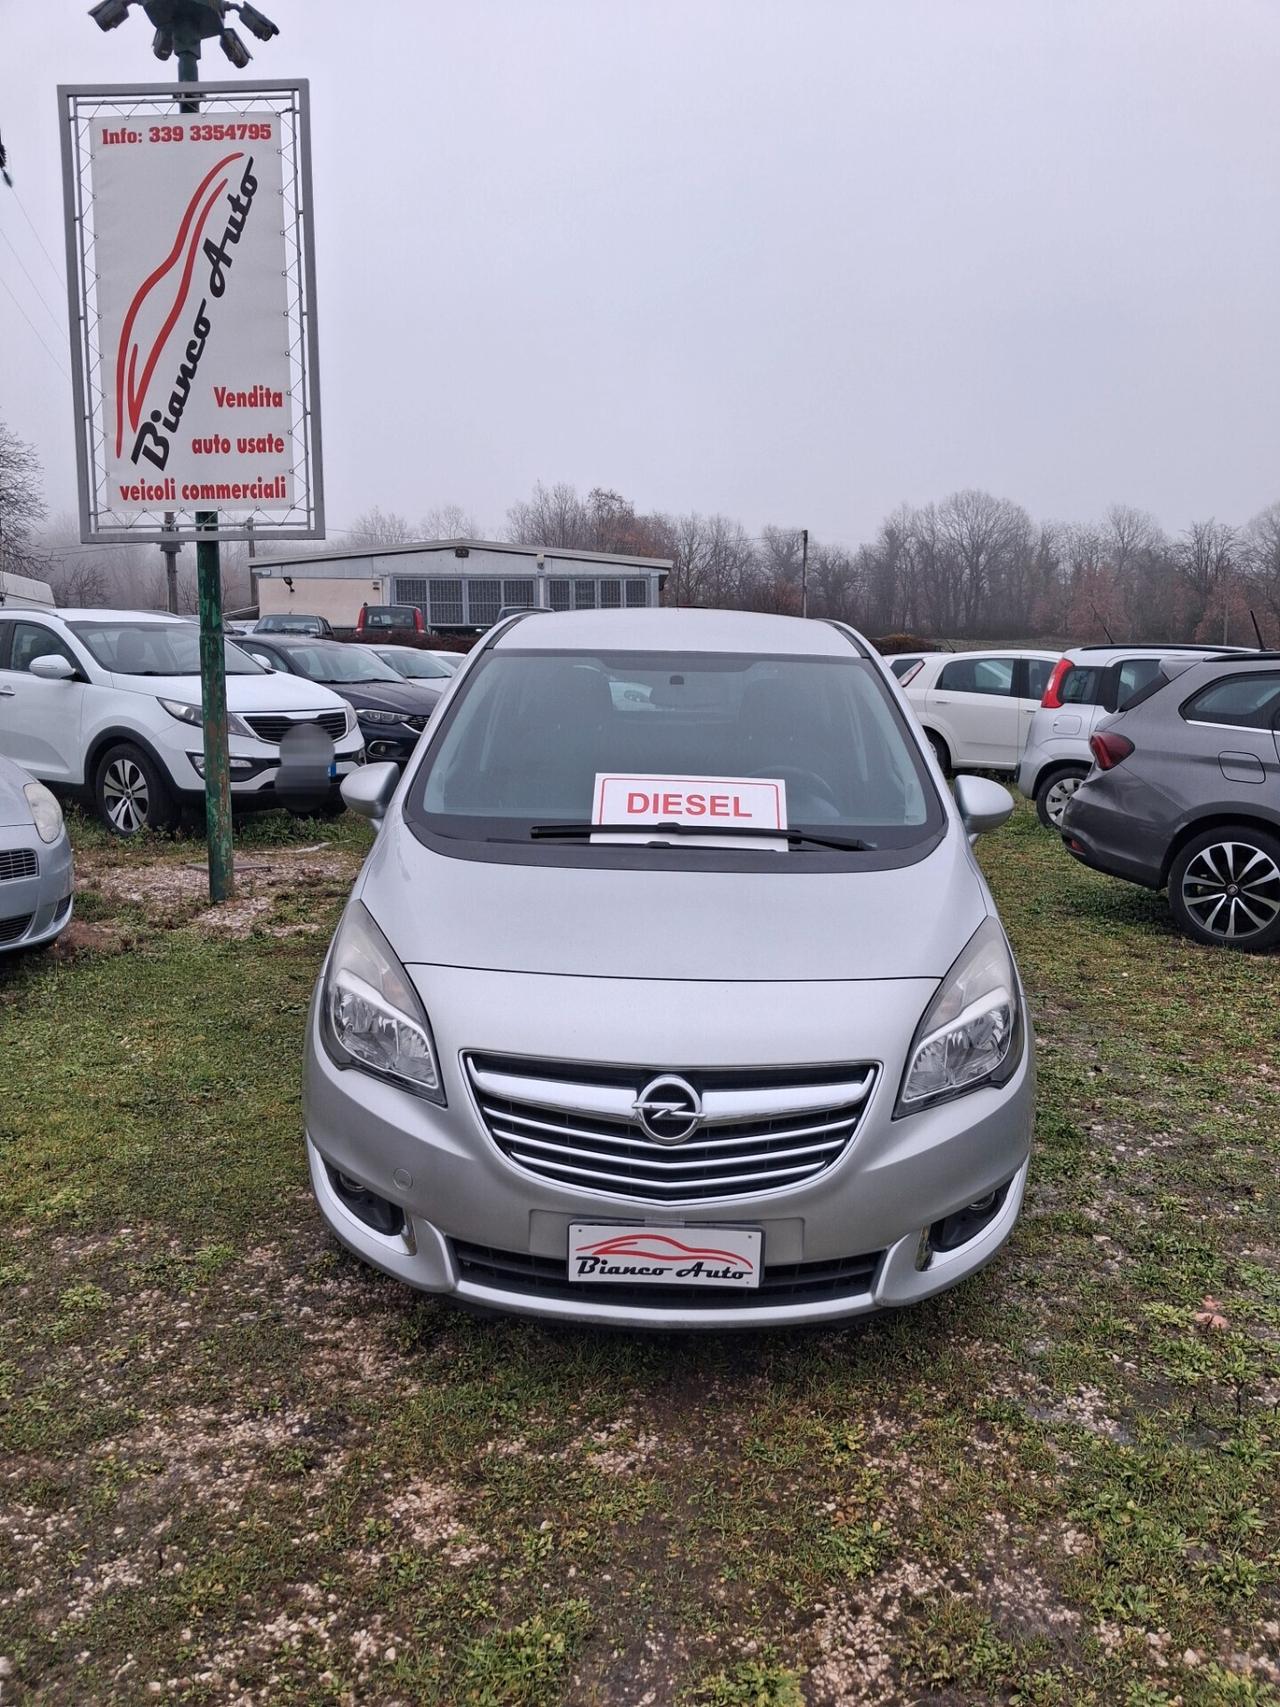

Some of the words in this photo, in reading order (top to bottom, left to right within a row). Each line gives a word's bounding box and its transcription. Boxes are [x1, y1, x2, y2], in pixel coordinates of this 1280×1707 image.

[102, 128, 143, 145] Info:
[149, 126, 184, 143] 339
[190, 123, 272, 142] 3354795
[130, 298, 212, 472] Bianco
[203, 156, 259, 298] Auto
[213, 385, 283, 408] Vendita
[191, 434, 231, 454] auto
[236, 433, 285, 454] usate
[119, 478, 177, 501] veicoli
[181, 476, 287, 501] commerciali
[626, 792, 753, 818] DIESEL
[575, 1256, 673, 1276] Bianco
[675, 1261, 753, 1280] Auto
